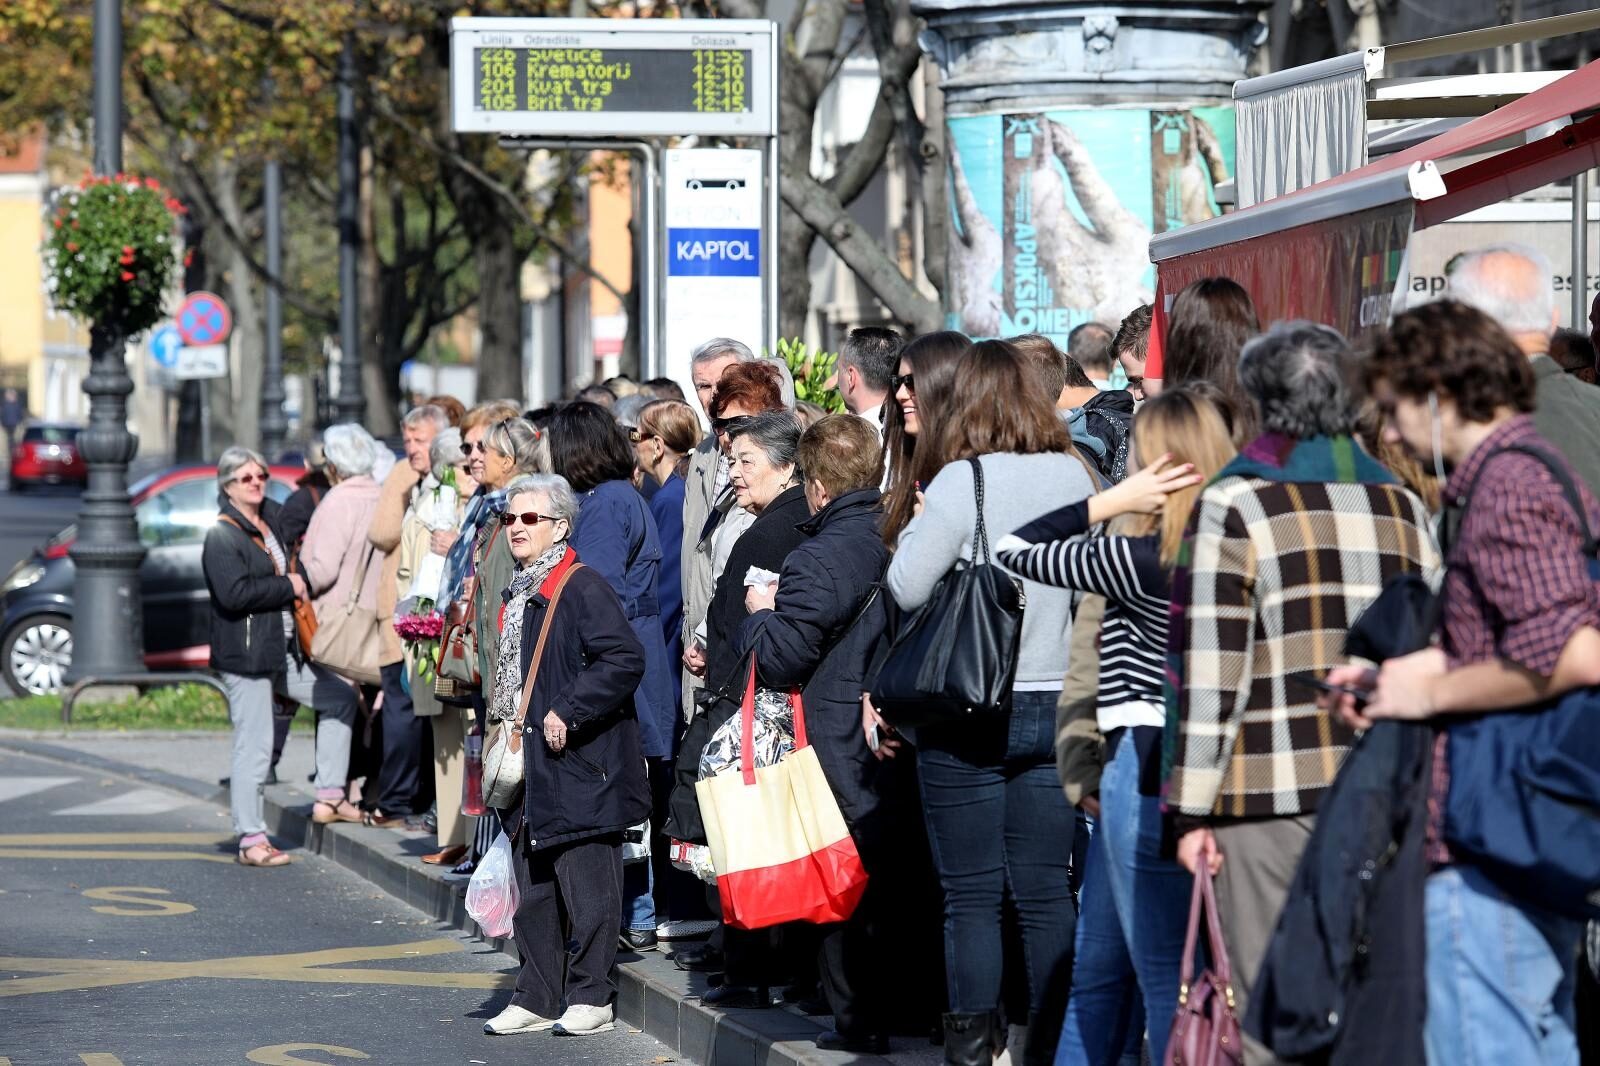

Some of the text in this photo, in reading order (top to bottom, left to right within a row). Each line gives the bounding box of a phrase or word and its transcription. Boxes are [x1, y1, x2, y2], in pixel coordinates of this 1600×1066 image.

[480, 63, 744, 80] 106 Krematorij 12:10
[480, 79, 516, 95] 201
[581, 79, 613, 96] trg
[692, 80, 744, 95] 12:10
[480, 95, 517, 111] 105
[573, 95, 603, 112] trg
[692, 96, 744, 112] 12:15
[676, 240, 755, 261] KAPTOL
